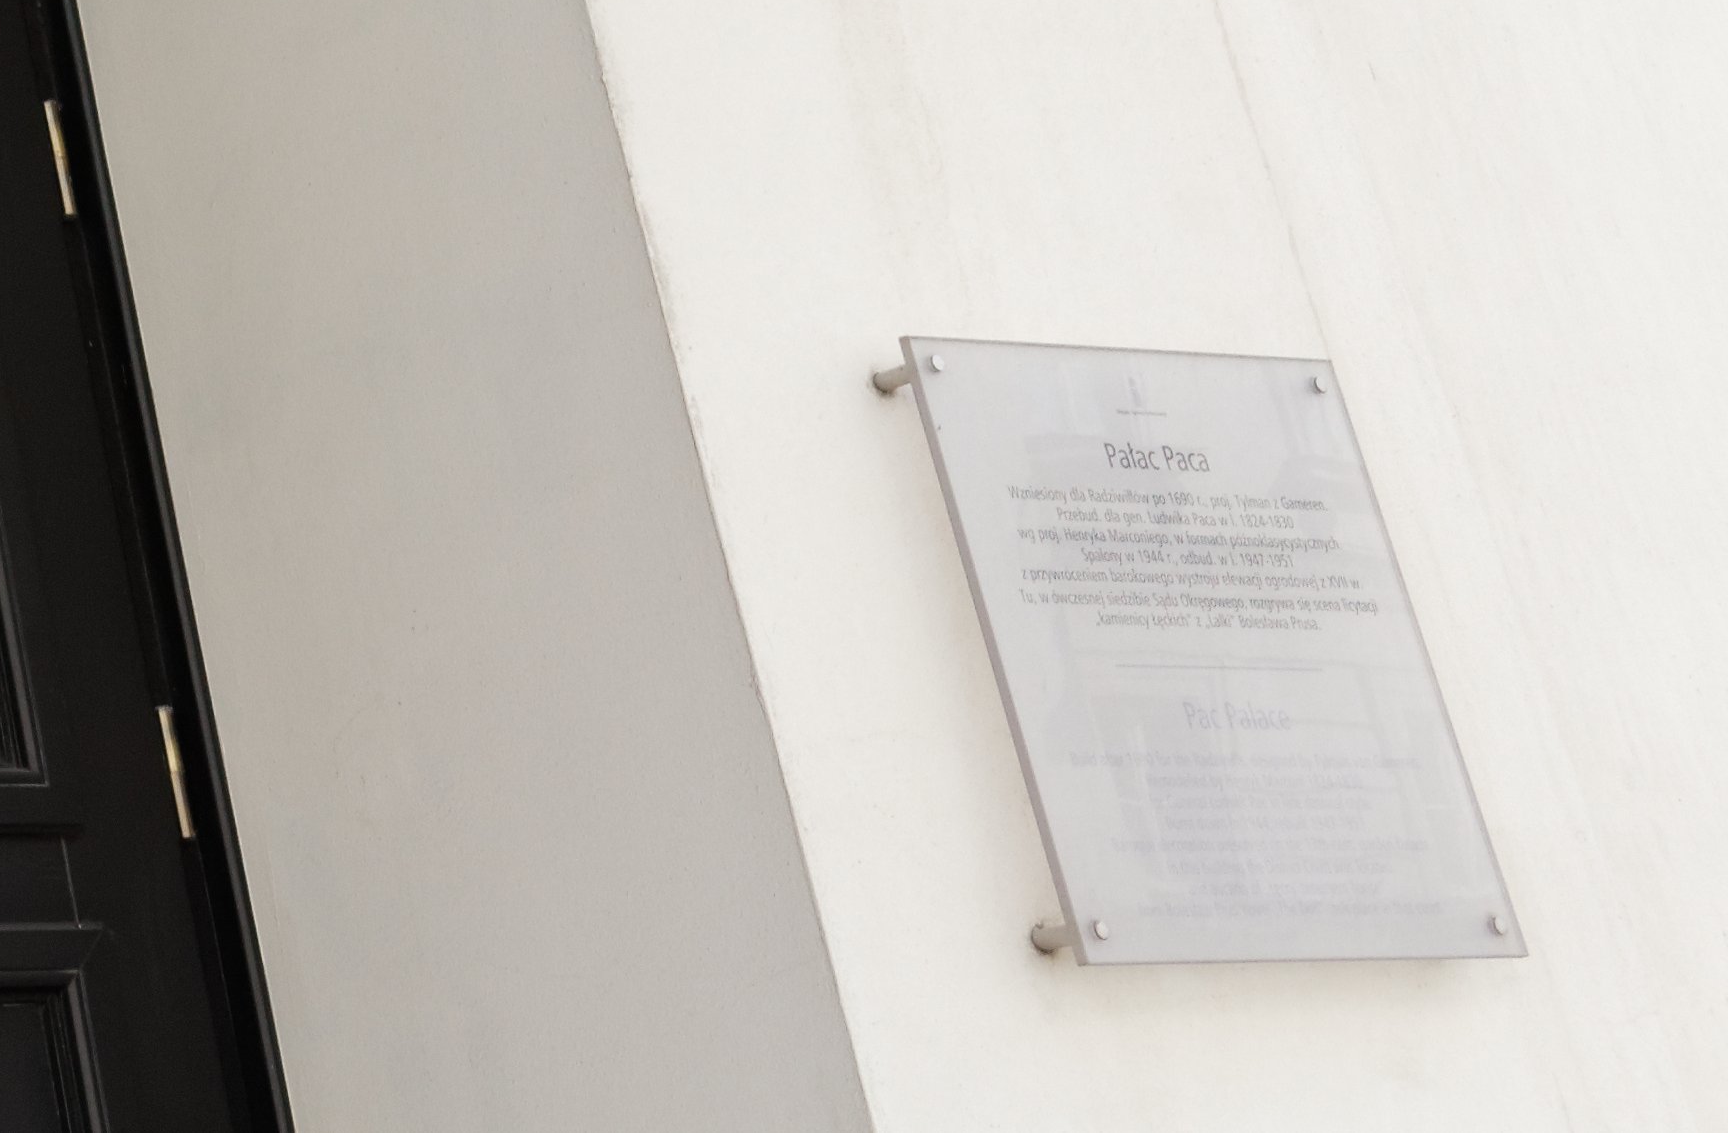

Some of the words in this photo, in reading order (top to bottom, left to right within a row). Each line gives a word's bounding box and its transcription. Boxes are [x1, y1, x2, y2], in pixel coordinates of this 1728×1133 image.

[1103, 441, 1160, 471] Pałac
[1161, 444, 1211, 473] Paca
[1007, 484, 1067, 505] Wzniesiony
[1069, 485, 1086, 503] dla
[1151, 493, 1166, 508] po
[1168, 491, 1195, 506] 1690
[1234, 494, 1271, 512] Tylman
[1273, 499, 1280, 510] z
[1056, 506, 1102, 522] Przebud.
[1104, 507, 1121, 524] dla
[1123, 512, 1146, 527] gen.
[1146, 510, 1191, 525] Ludwika
[1192, 512, 1216, 527] Paca
[1218, 516, 1229, 527] w
[1239, 513, 1295, 529] 1824-1830
[1017, 530, 1035, 544] wg
[1064, 527, 1107, 545] Henryka
[1107, 529, 1173, 547] Marconiego,
[1173, 534, 1184, 544] w
[1185, 530, 1228, 546] formach
[1080, 546, 1123, 566] Spalony
[1125, 552, 1135, 562] w
[1137, 549, 1164, 563] 1944
[1180, 550, 1216, 565] odbud.
[1217, 555, 1227, 565] w
[1239, 552, 1294, 568] 1947-1951
[1021, 569, 1027, 580] z
[1109, 567, 1175, 587] barokowego
[1175, 571, 1220, 590] wystroju
[1221, 571, 1262, 591] elewacji
[1265, 574, 1320, 592] ogrodowej
[1320, 578, 1326, 589] z
[1018, 587, 1038, 606] Tu,
[1039, 592, 1049, 604] w
[1051, 589, 1107, 609] ówczesnej
[1107, 589, 1150, 607] siedzibie
[1151, 592, 1178, 609] Sądu
[1179, 593, 1248, 613] Okręgowego,
[1249, 597, 1294, 614] rozgrywa
[1296, 596, 1312, 613] się
[1313, 599, 1341, 611] scena
[1341, 597, 1380, 616] licytacji
[1195, 616, 1202, 628] z
[1237, 615, 1290, 631] Bolesława
[1182, 701, 1222, 730] Pac
[1224, 701, 1292, 732] Palace
